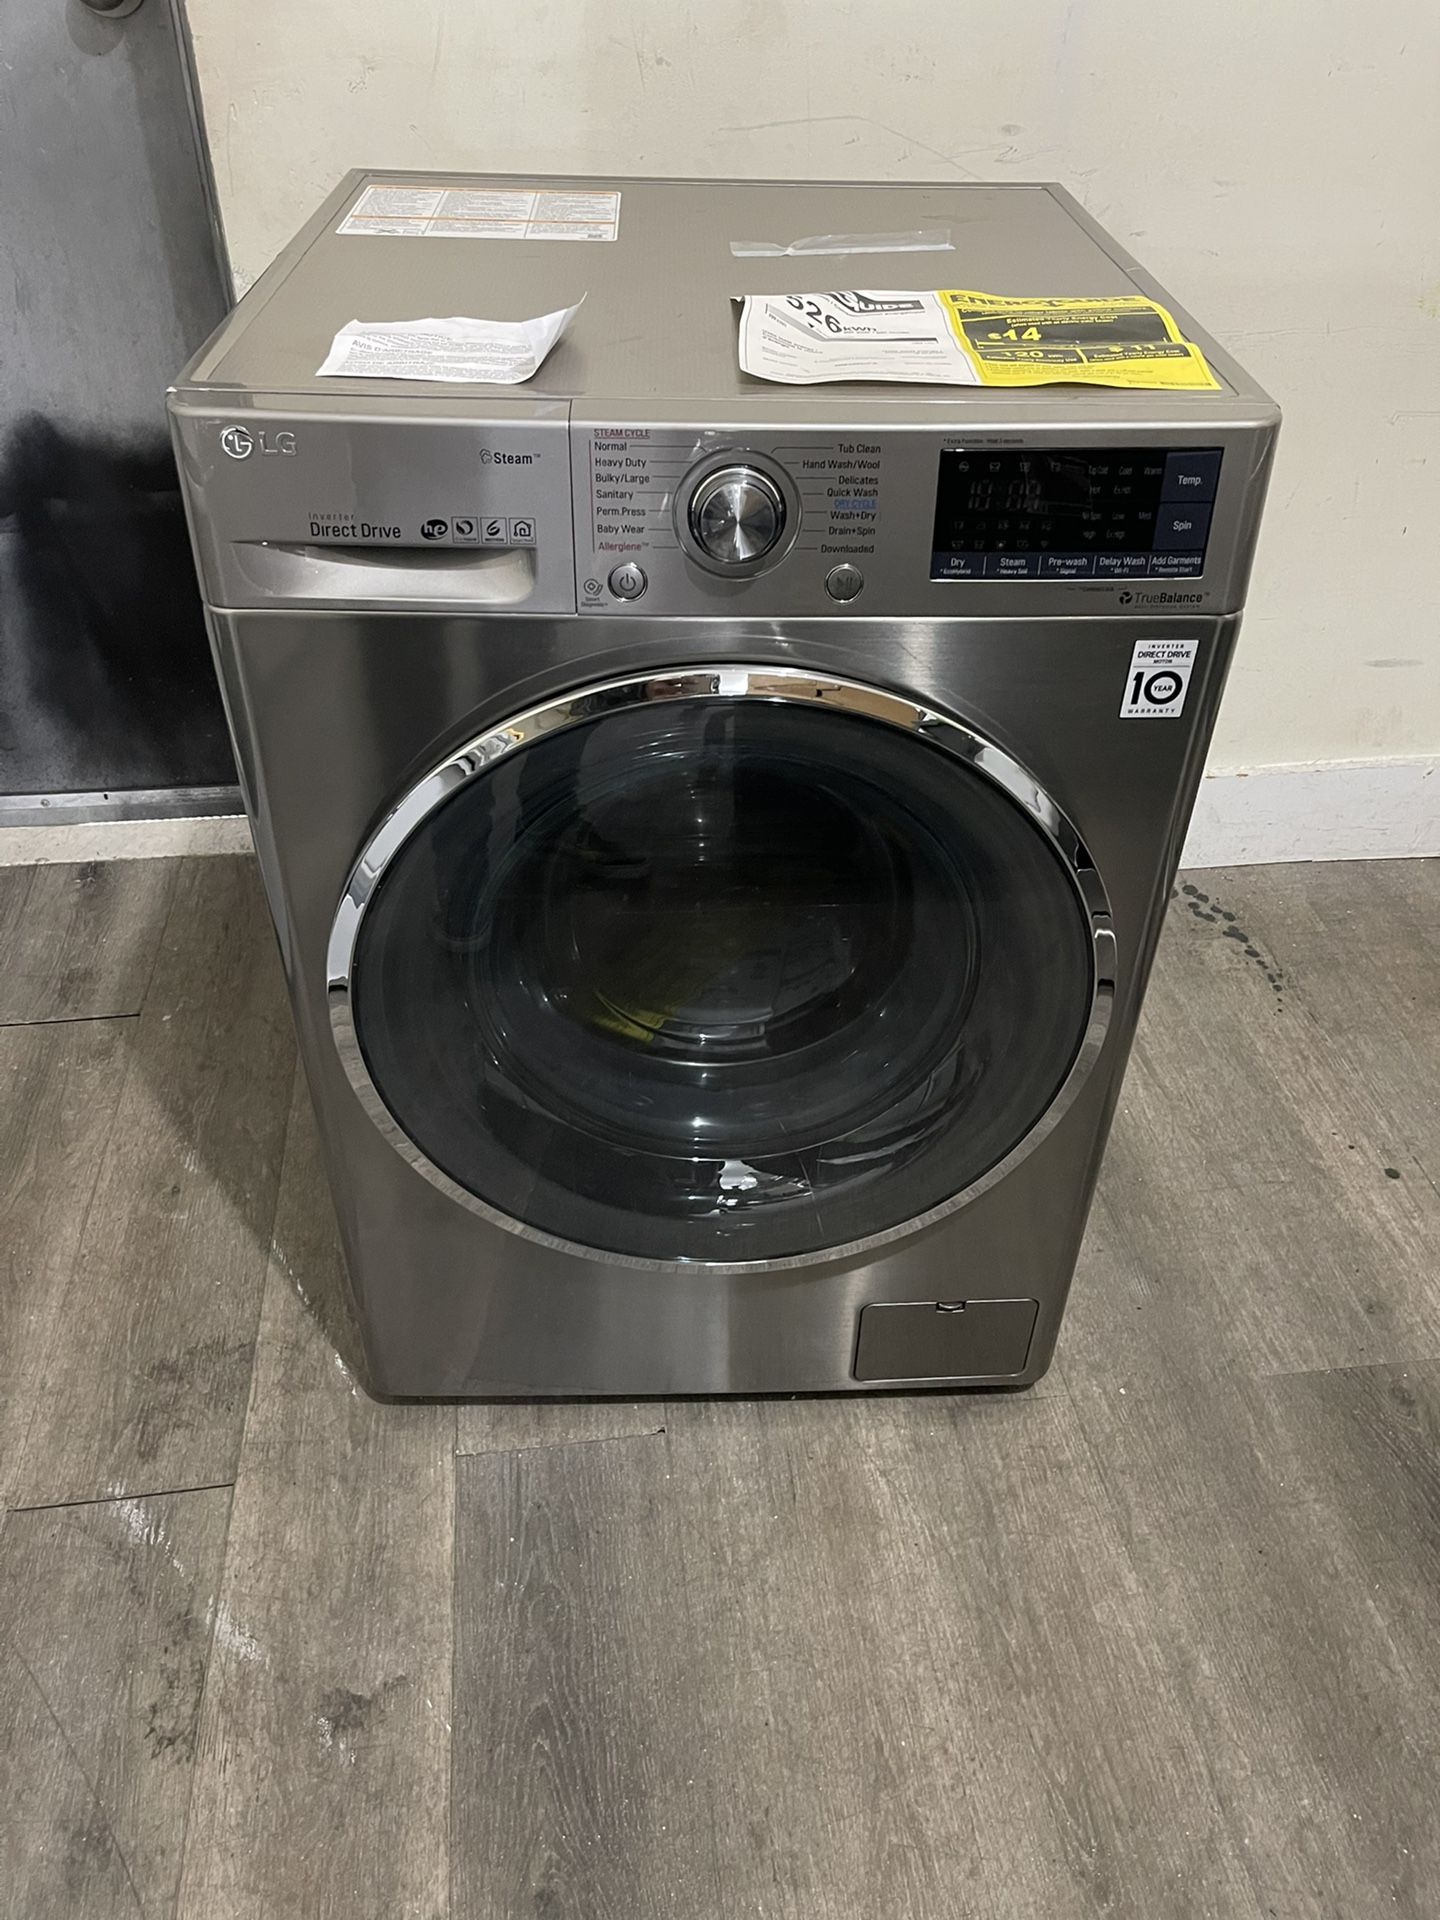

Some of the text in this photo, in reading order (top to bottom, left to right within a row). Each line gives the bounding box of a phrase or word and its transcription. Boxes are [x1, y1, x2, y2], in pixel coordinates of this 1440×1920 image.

[594, 428, 650, 437] STEAM CYCLE
[258, 431, 297, 456] LG
[594, 442, 627, 451] Normal
[838, 444, 881, 453] Tub Clean
[594, 458, 647, 468] Heavy Duty
[802, 460, 880, 469] Hand Wash/Wool
[595, 474, 650, 484] Bulky/Large
[838, 475, 878, 485] Delicates
[596, 490, 634, 500] Sanitary
[827, 488, 878, 497] Quick Wash
[621, 507, 646, 516] Press
[308, 513, 354, 521] Inverter
[310, 521, 401, 538] Direct Drive
[597, 524, 646, 535] Baby Wear
[1173, 520, 1192, 531] Spin
[821, 544, 875, 553] Downloaded
[950, 555, 1202, 568] Dry Steam Pre-wash Delay Wash Add Garments
[1130, 670, 1183, 705] 10
